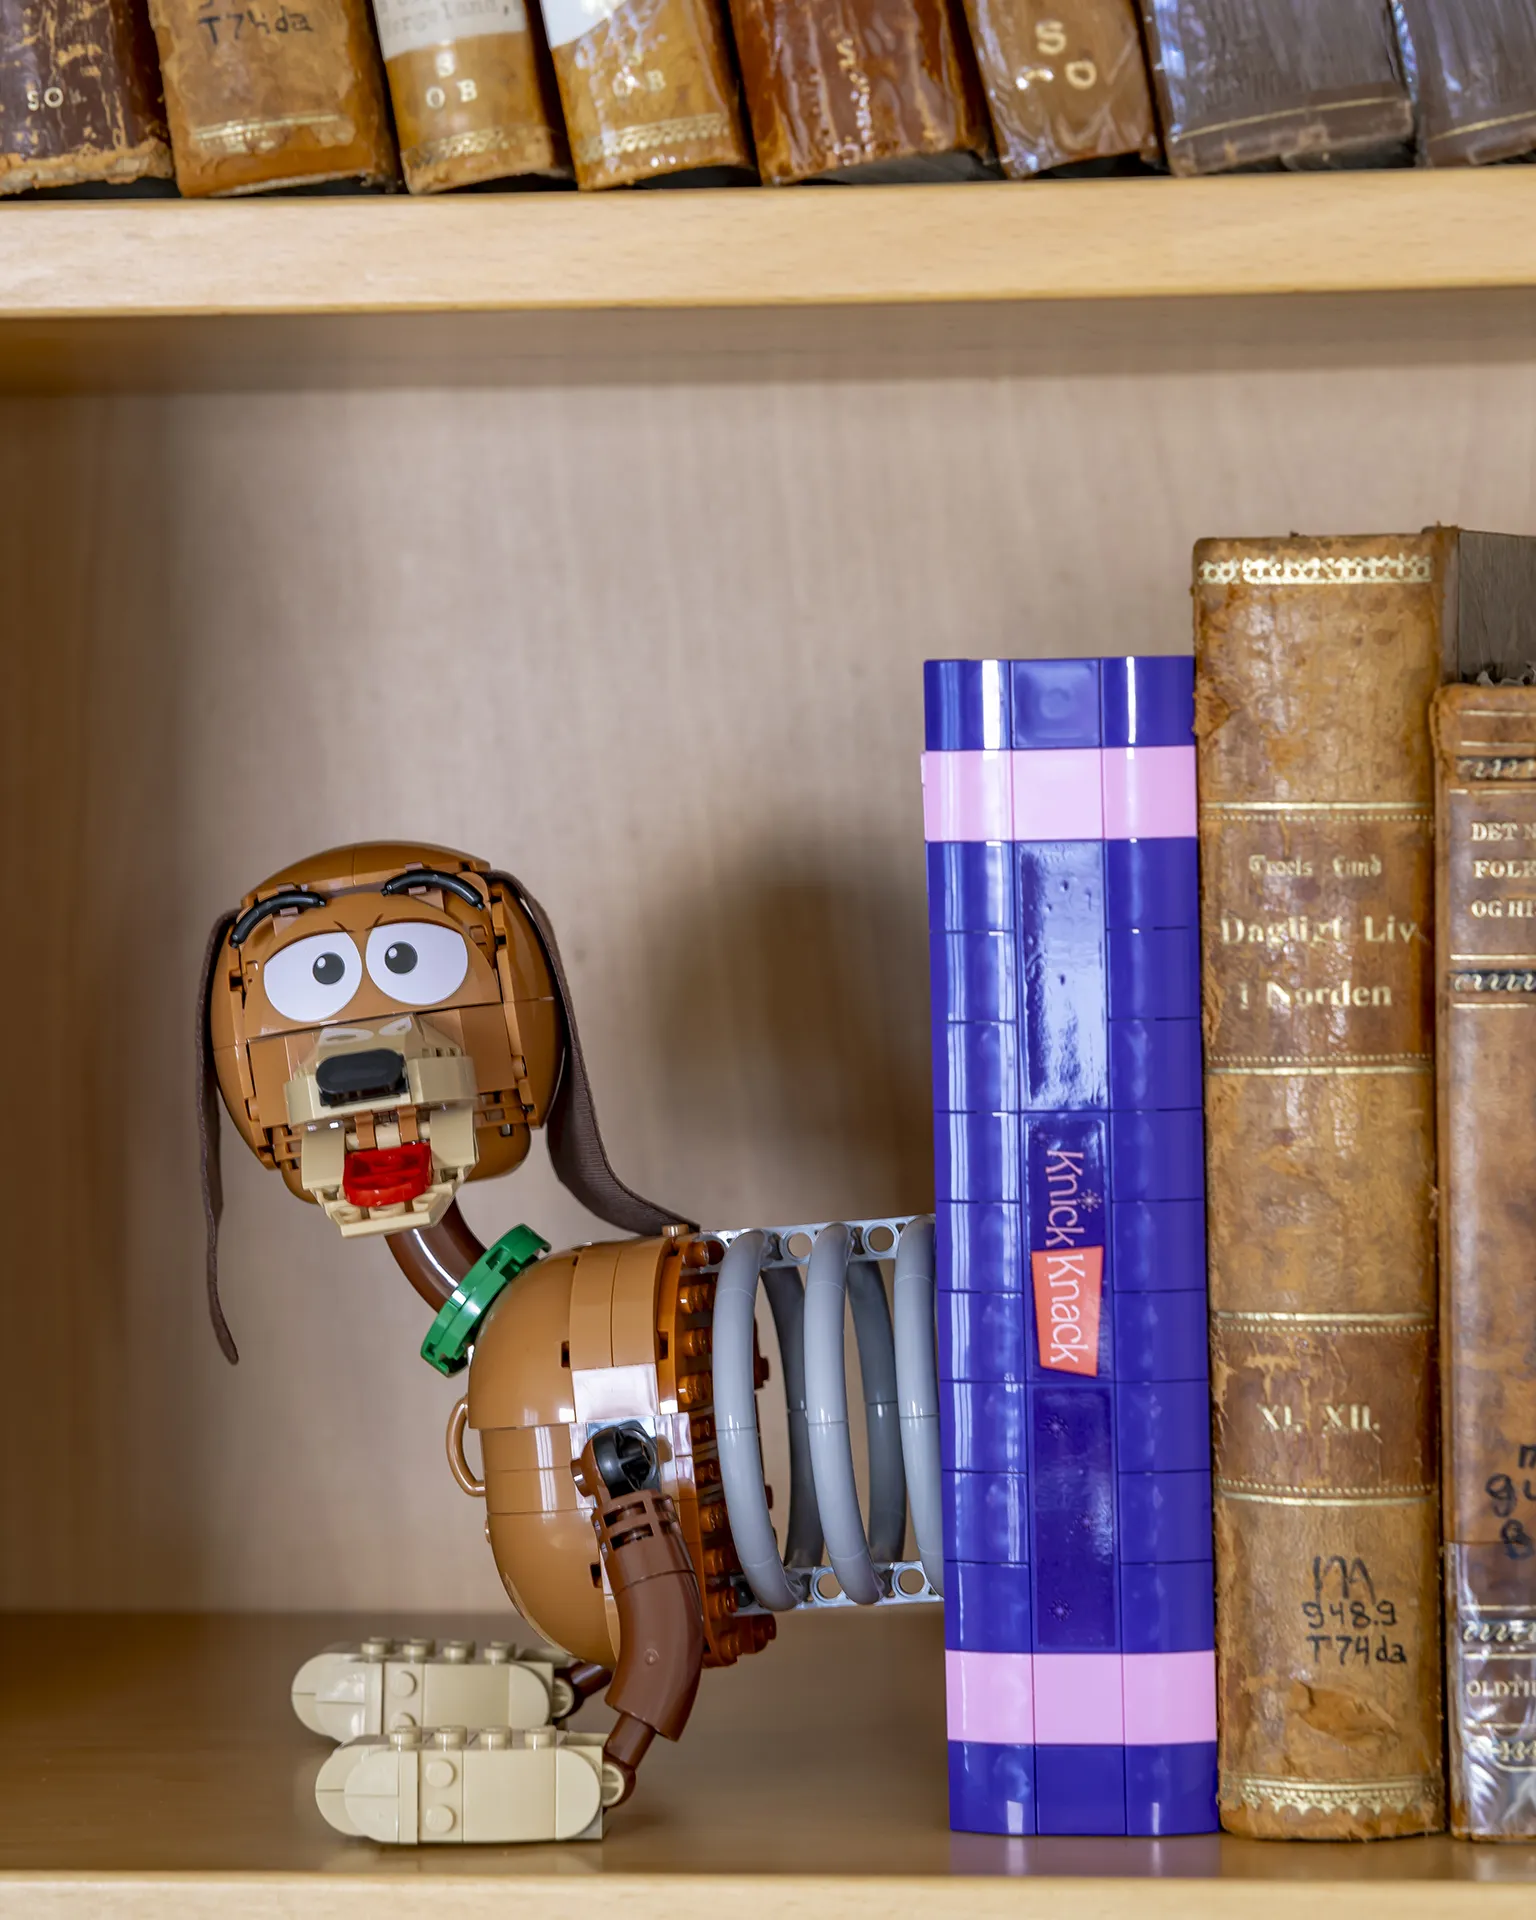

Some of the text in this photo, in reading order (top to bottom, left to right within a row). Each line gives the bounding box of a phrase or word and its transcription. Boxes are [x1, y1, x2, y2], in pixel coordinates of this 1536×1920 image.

[1471, 821, 1518, 841] DET
[1470, 899, 1536, 918] OG HI
[1363, 915, 1418, 944] Liv
[1266, 979, 1394, 1009] Norden
[1045, 1149, 1101, 1247] Knick
[1046, 1253, 1089, 1364] Knack
[1301, 1600, 1398, 1629] 948.9
[1305, 1634, 1408, 1665] T74da
